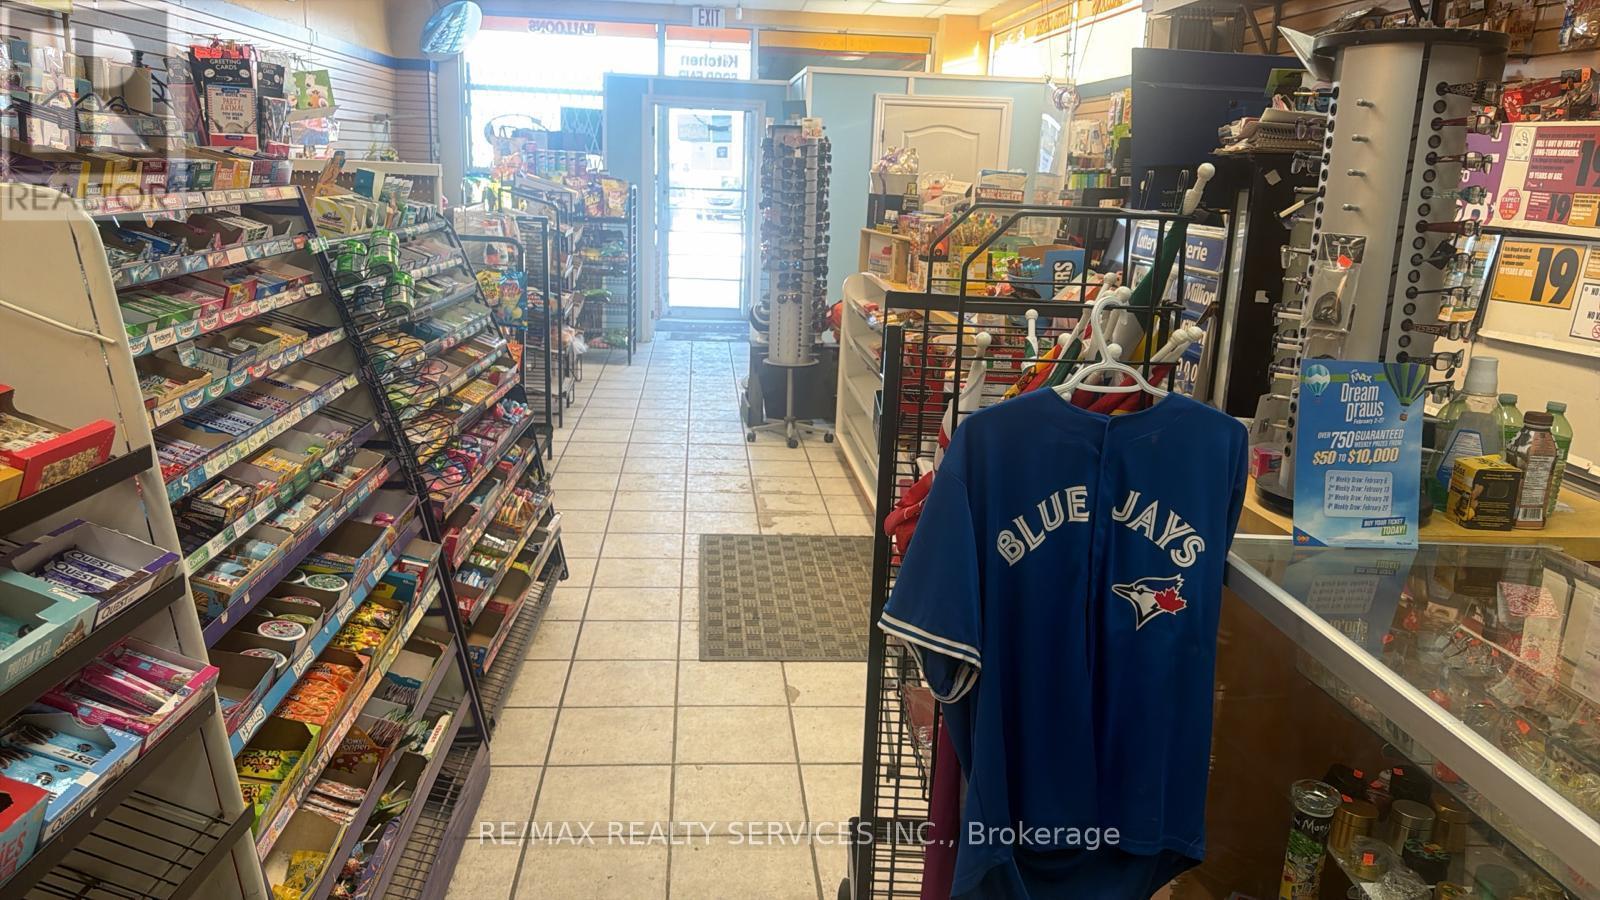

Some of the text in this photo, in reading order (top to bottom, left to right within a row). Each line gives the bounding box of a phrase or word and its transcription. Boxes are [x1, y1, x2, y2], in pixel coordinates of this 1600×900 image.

[698, 8, 720, 27] EXIT
[145, 174, 165, 185] HALLS
[1547, 193, 1571, 221] 19
[1530, 247, 1579, 304] 19
[154, 333, 171, 344] Trident
[1341, 383, 1379, 402] Dream
[158, 405, 176, 418] Trident
[1346, 402, 1384, 422] Draws
[1318, 429, 1404, 449] OVER 750 GUARANTEED
[1312, 448, 1399, 466] $50 TO $10,000
[1335, 485, 1350, 493] Weekly
[1364, 476, 1383, 484] February
[1335, 494, 1349, 502] Weekly
[1363, 495, 1382, 503] February
[1334, 503, 1348, 512] Weekly
[1362, 504, 1381, 513] February
[996, 485, 1206, 568] BLUE JAYS
[1382, 526, 1406, 535] TODAY!
[71, 551, 111, 570] QUEST
[54, 562, 98, 582] QUEST
[102, 595, 130, 619] QUEST
[243, 757, 280, 766] PATCH
